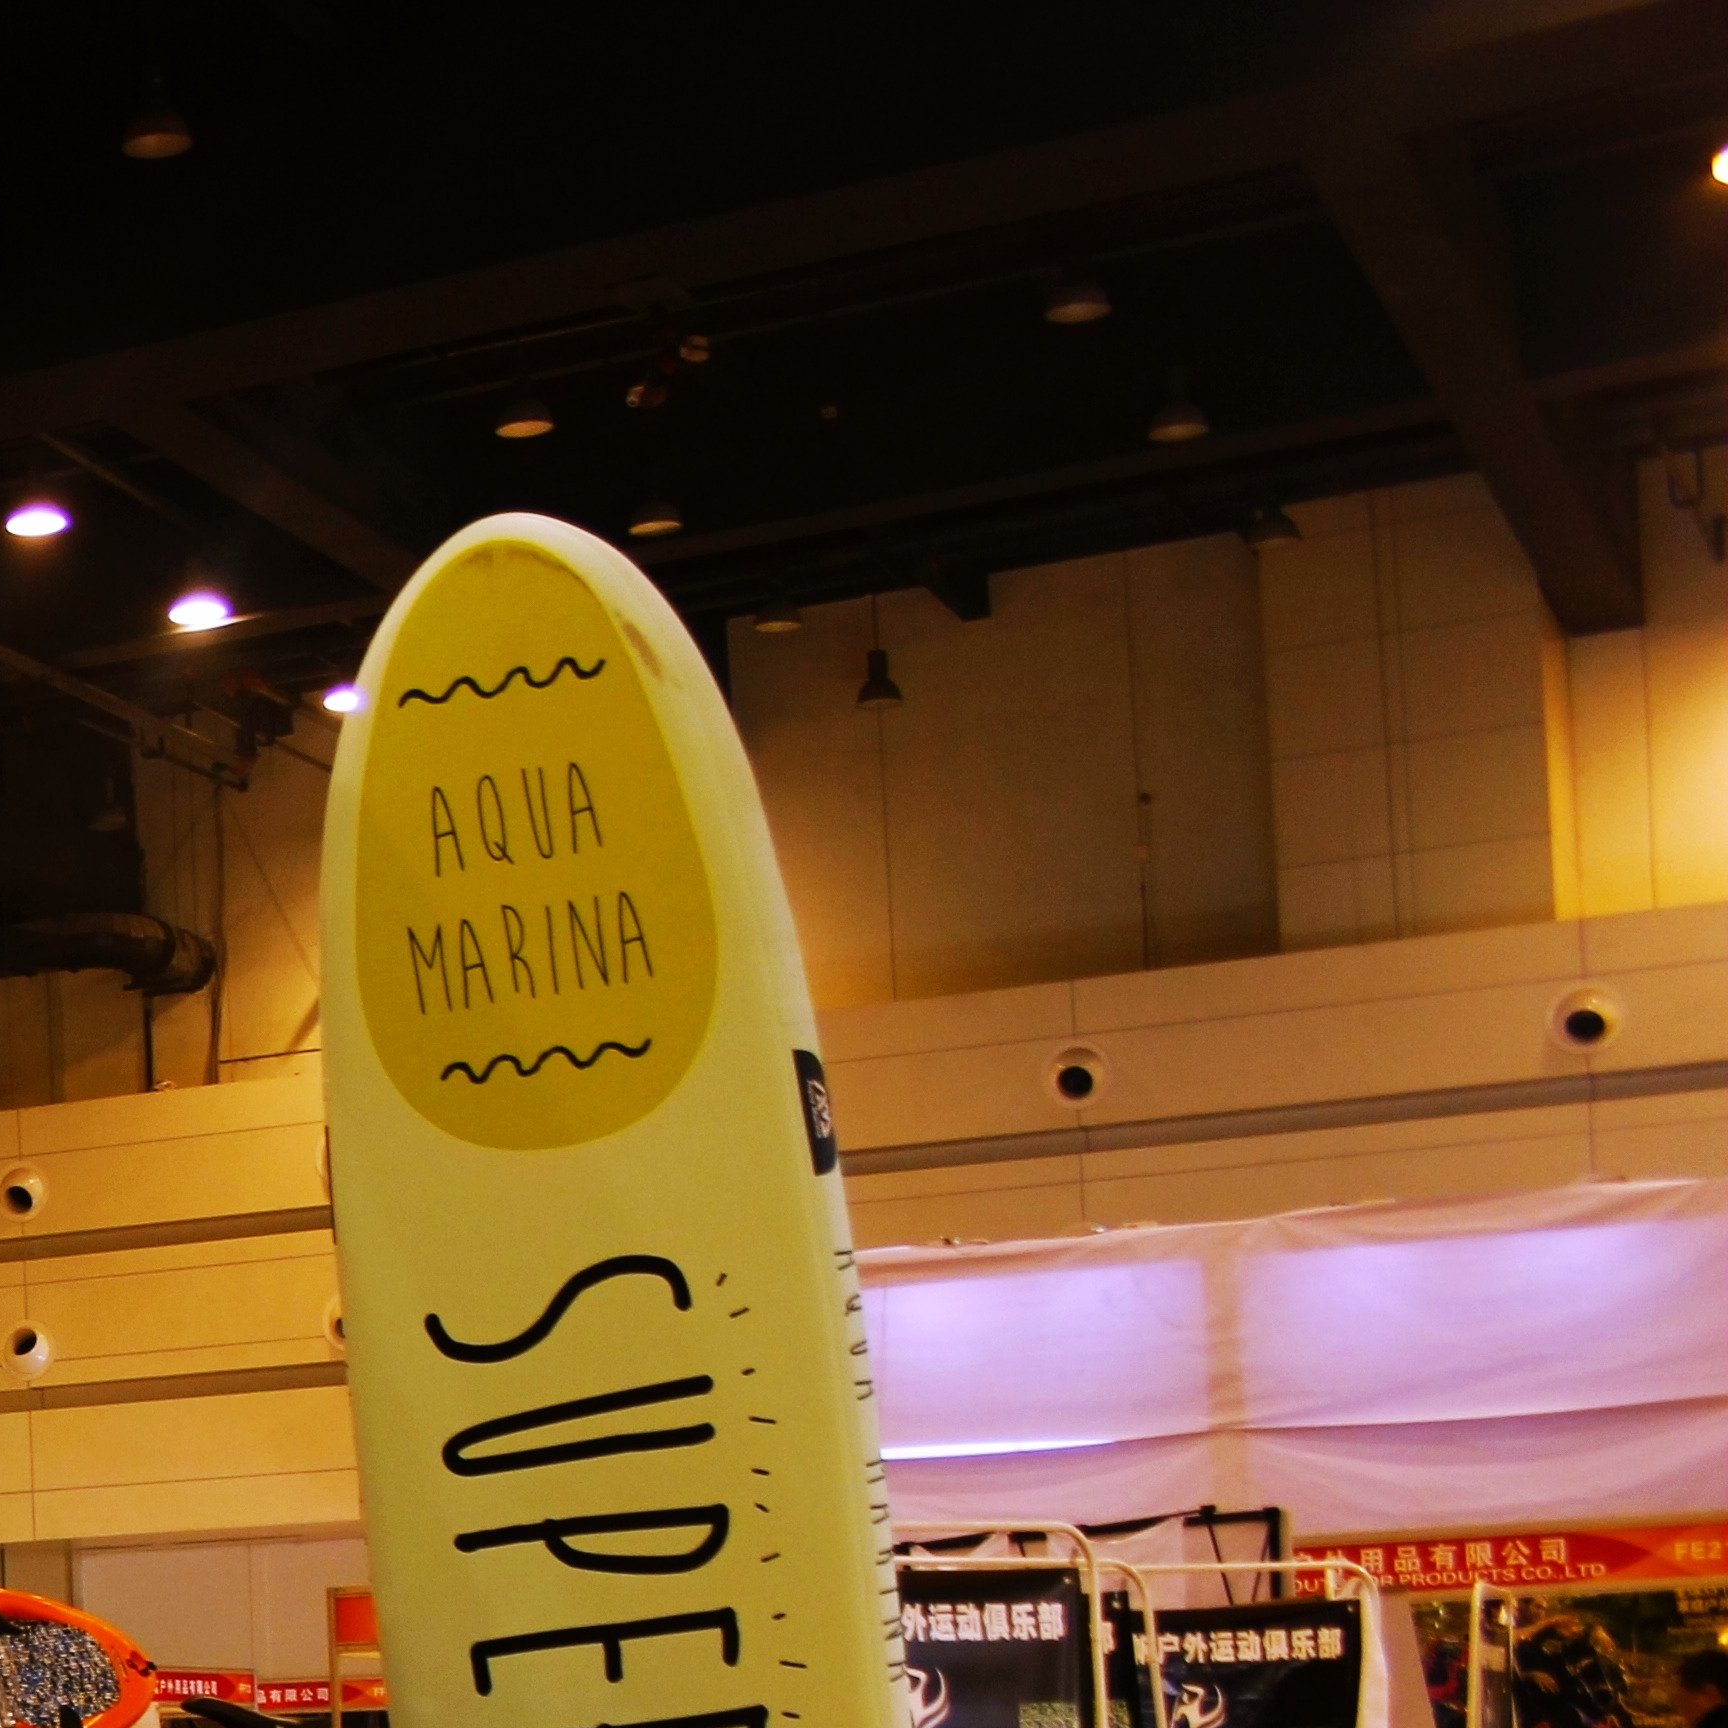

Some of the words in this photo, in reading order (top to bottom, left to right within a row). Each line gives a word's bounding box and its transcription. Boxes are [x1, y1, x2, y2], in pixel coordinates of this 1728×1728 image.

[431, 762, 604, 878] AQUA
[406, 891, 654, 1015] MARINA
[1399, 1567, 1517, 1587] PRODUCTS
